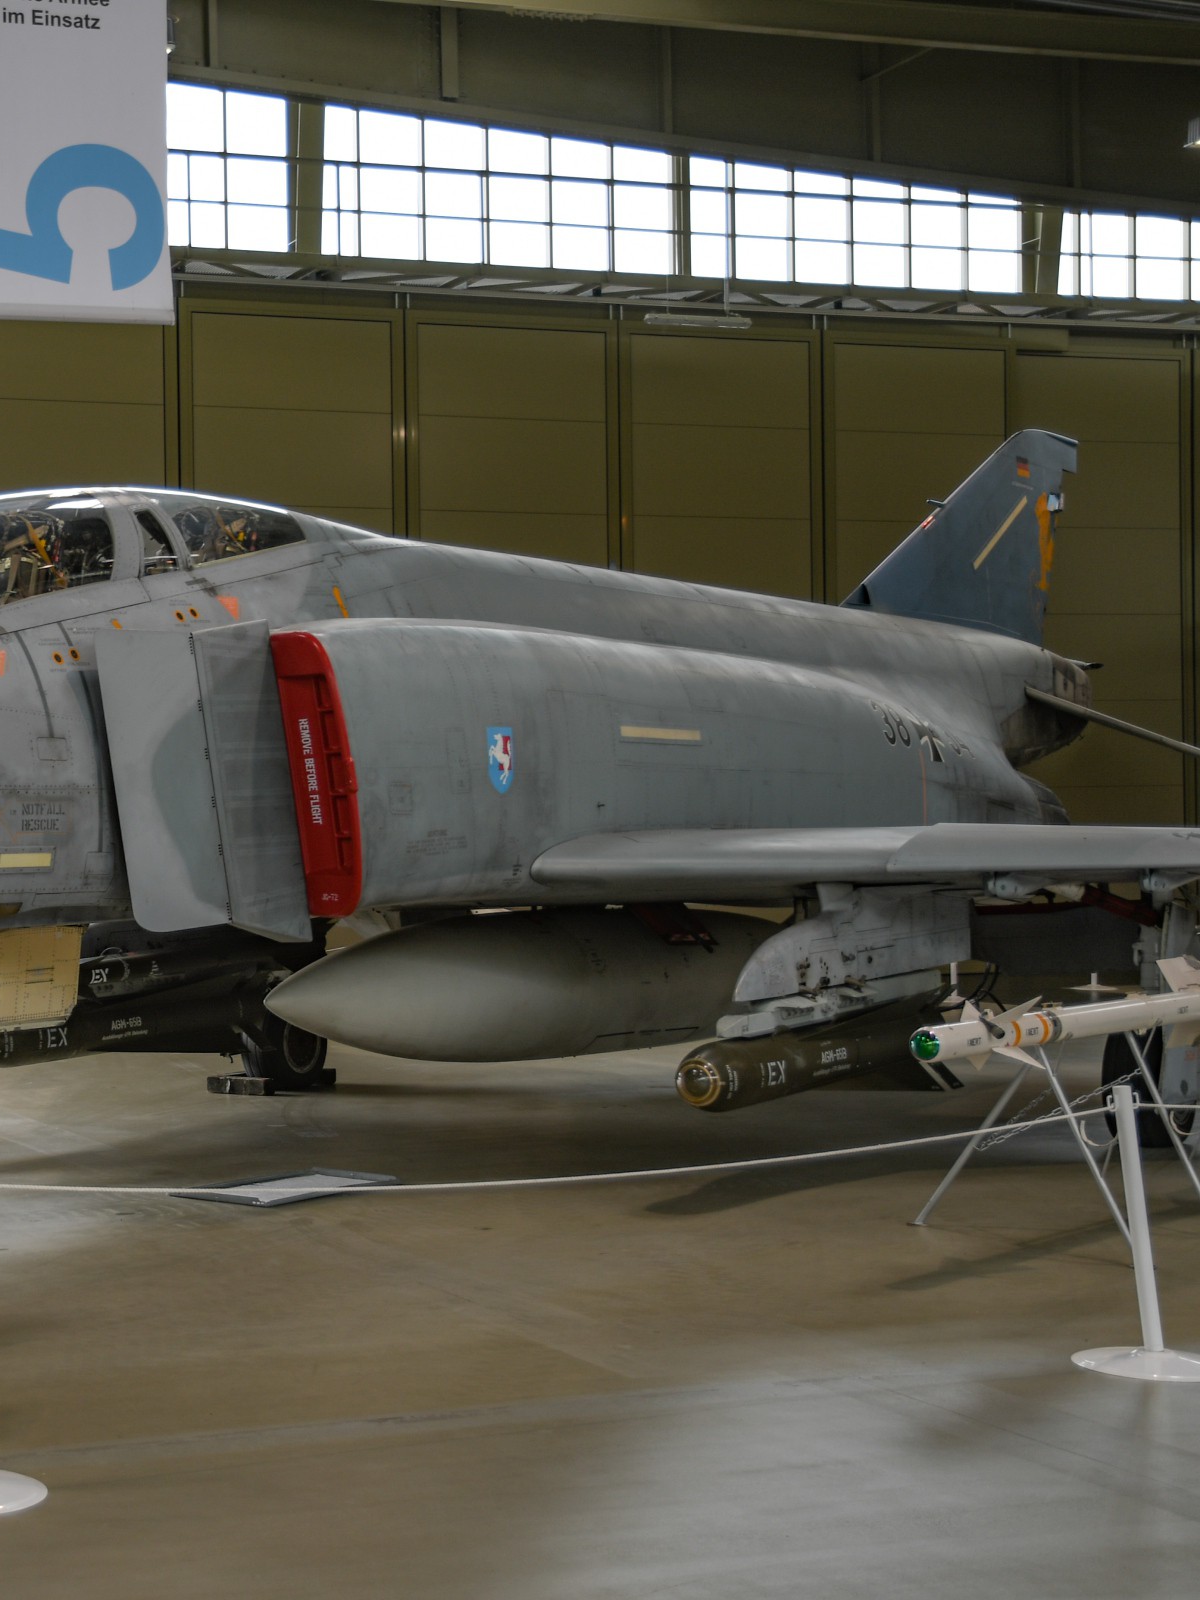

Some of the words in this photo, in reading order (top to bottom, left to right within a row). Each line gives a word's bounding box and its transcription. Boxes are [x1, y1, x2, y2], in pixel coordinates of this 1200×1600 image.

[2, 7, 24, 24] im
[31, 9, 101, 30] Einsatz
[298, 718, 313, 755] REMOVE
[870, 700, 911, 748] 38
[304, 757, 319, 792] BEFORE
[22, 803, 65, 815] NOTFALL
[309, 794, 323, 825] FLIGHT
[21, 818, 59, 831] RESCUE
[111, 1016, 142, 1031] AGM-65B
[47, 1027, 68, 1048] EX
[767, 1060, 786, 1087] EX
